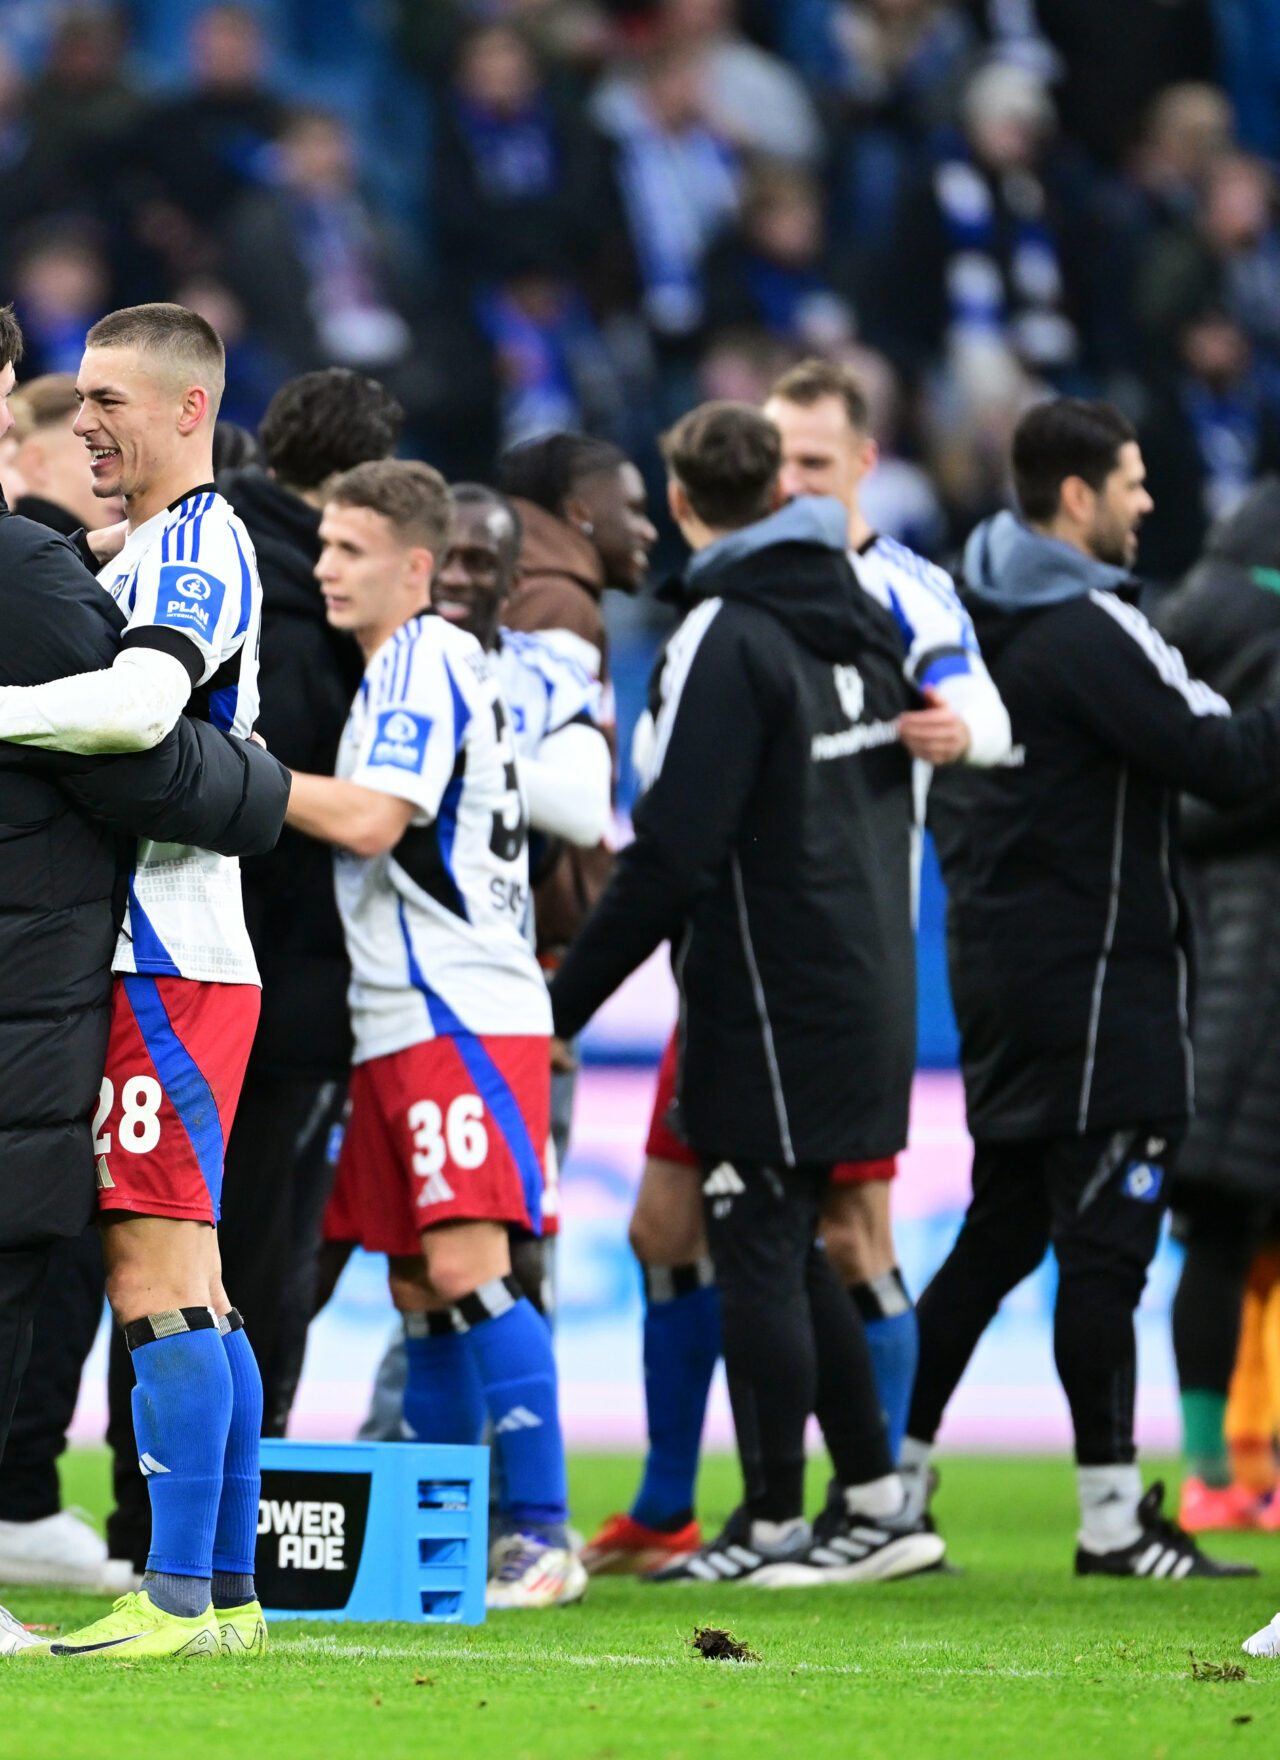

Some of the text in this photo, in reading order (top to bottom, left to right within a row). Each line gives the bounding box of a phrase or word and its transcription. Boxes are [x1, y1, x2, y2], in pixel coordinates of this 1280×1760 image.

[166, 600, 210, 626] PLAN
[91, 1074, 163, 1155] 28
[407, 1093, 489, 1178] 36
[256, 1499, 346, 1537] OWER
[278, 1534, 346, 1571] ADE
